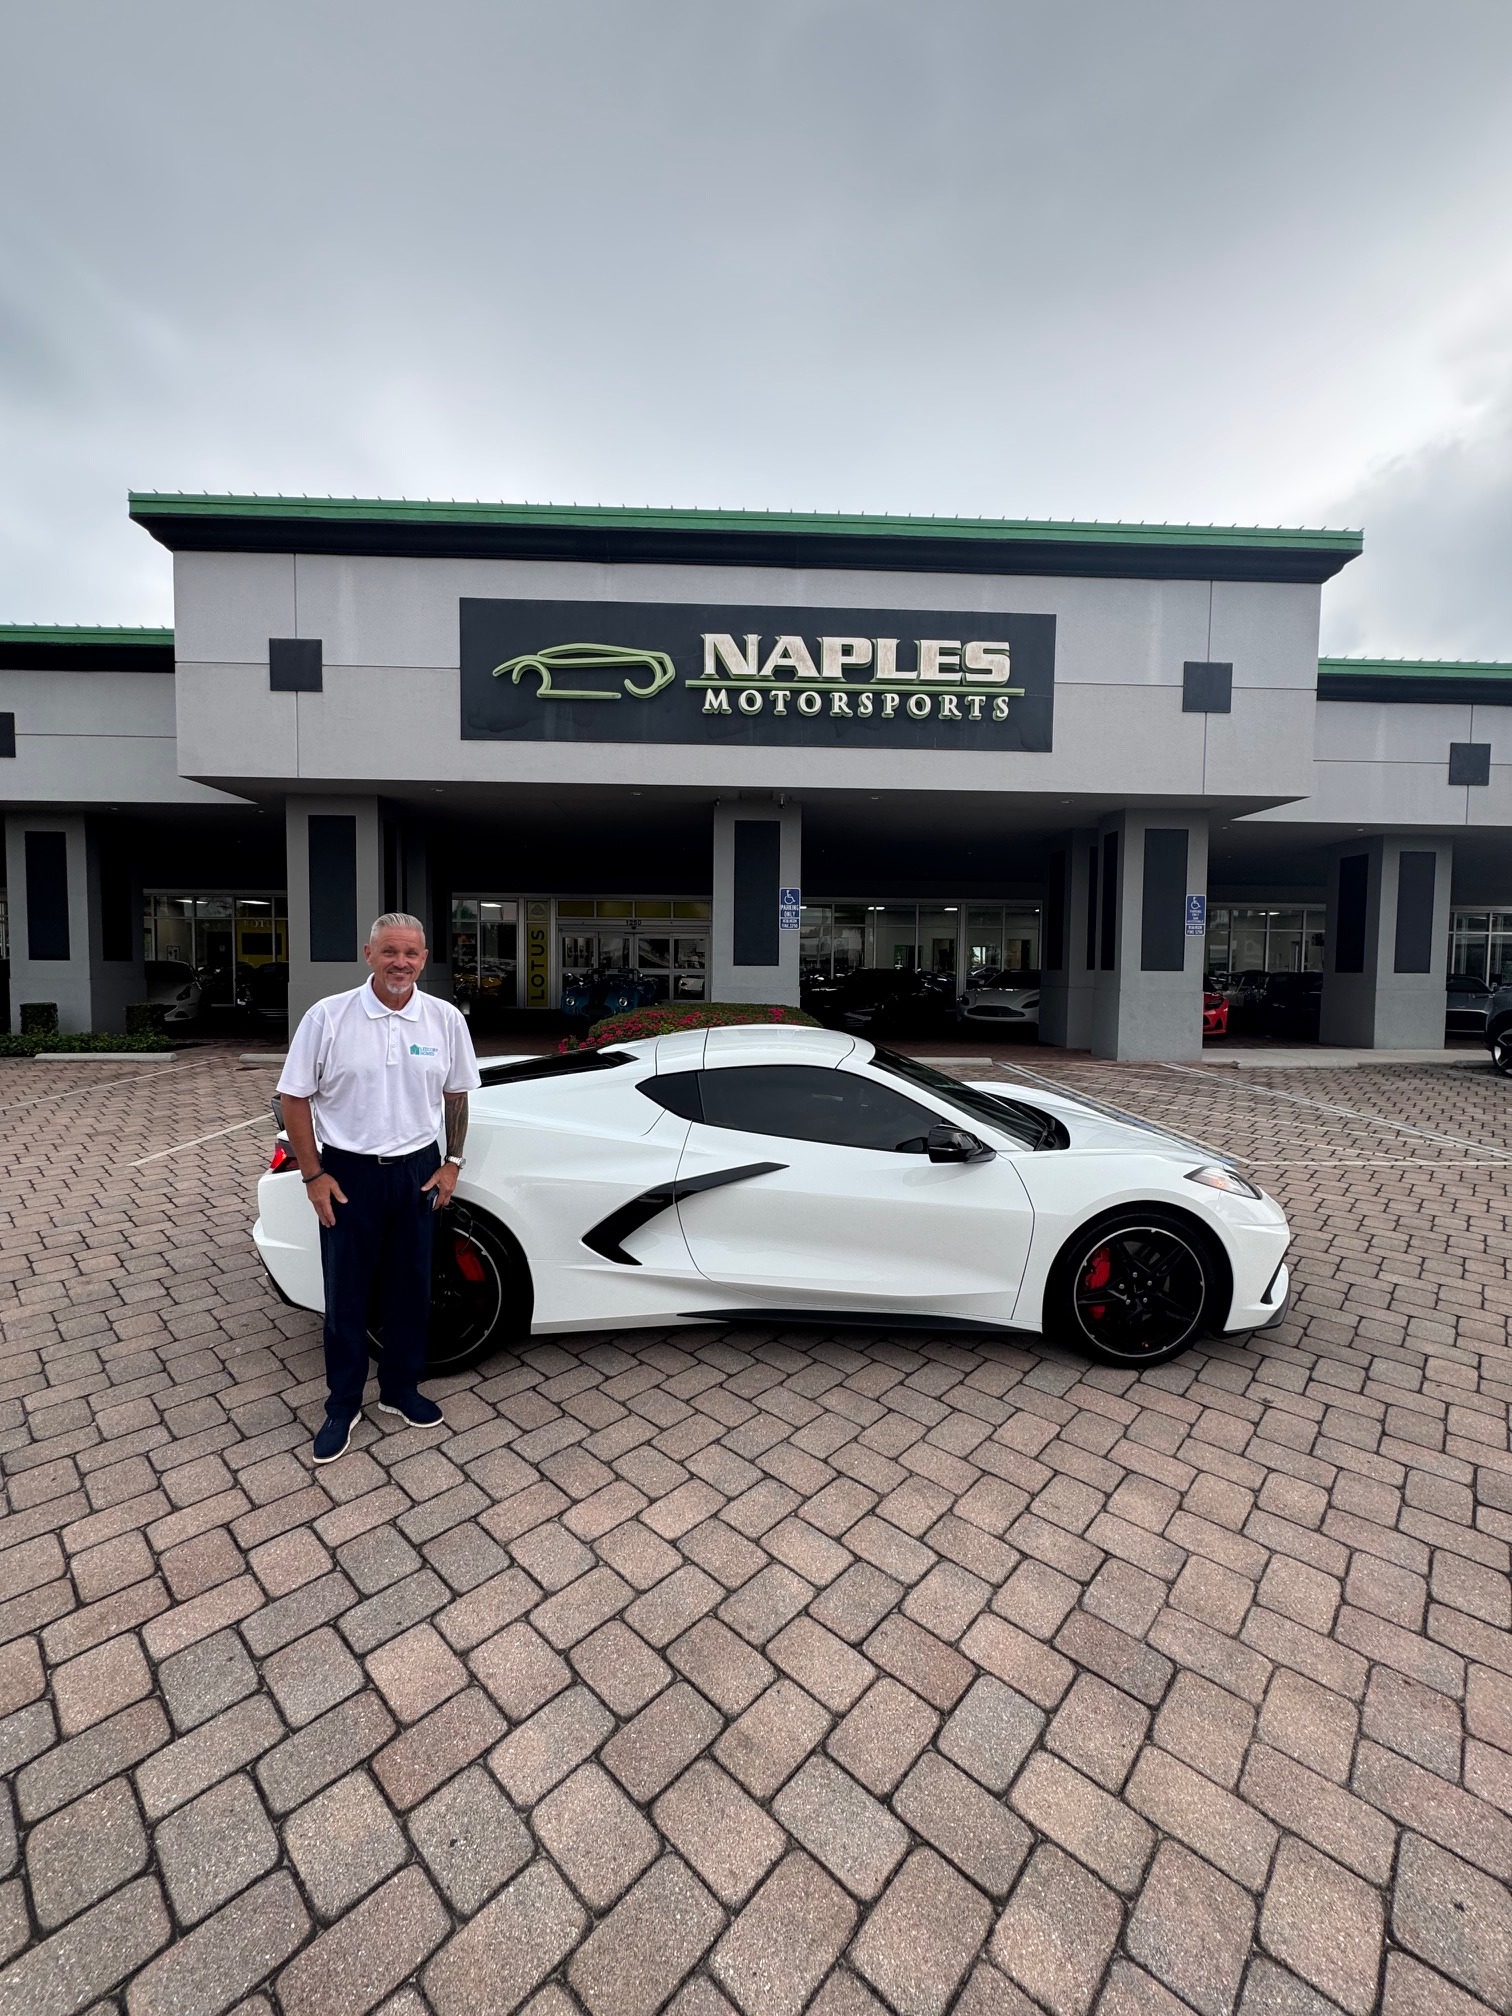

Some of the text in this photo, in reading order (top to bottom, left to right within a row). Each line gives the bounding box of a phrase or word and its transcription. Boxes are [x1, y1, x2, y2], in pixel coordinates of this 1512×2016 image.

[701, 633, 1011, 686] NAPLES
[703, 688, 1010, 721] MOTORSPORTS
[530, 930, 545, 1000] LOTUS
